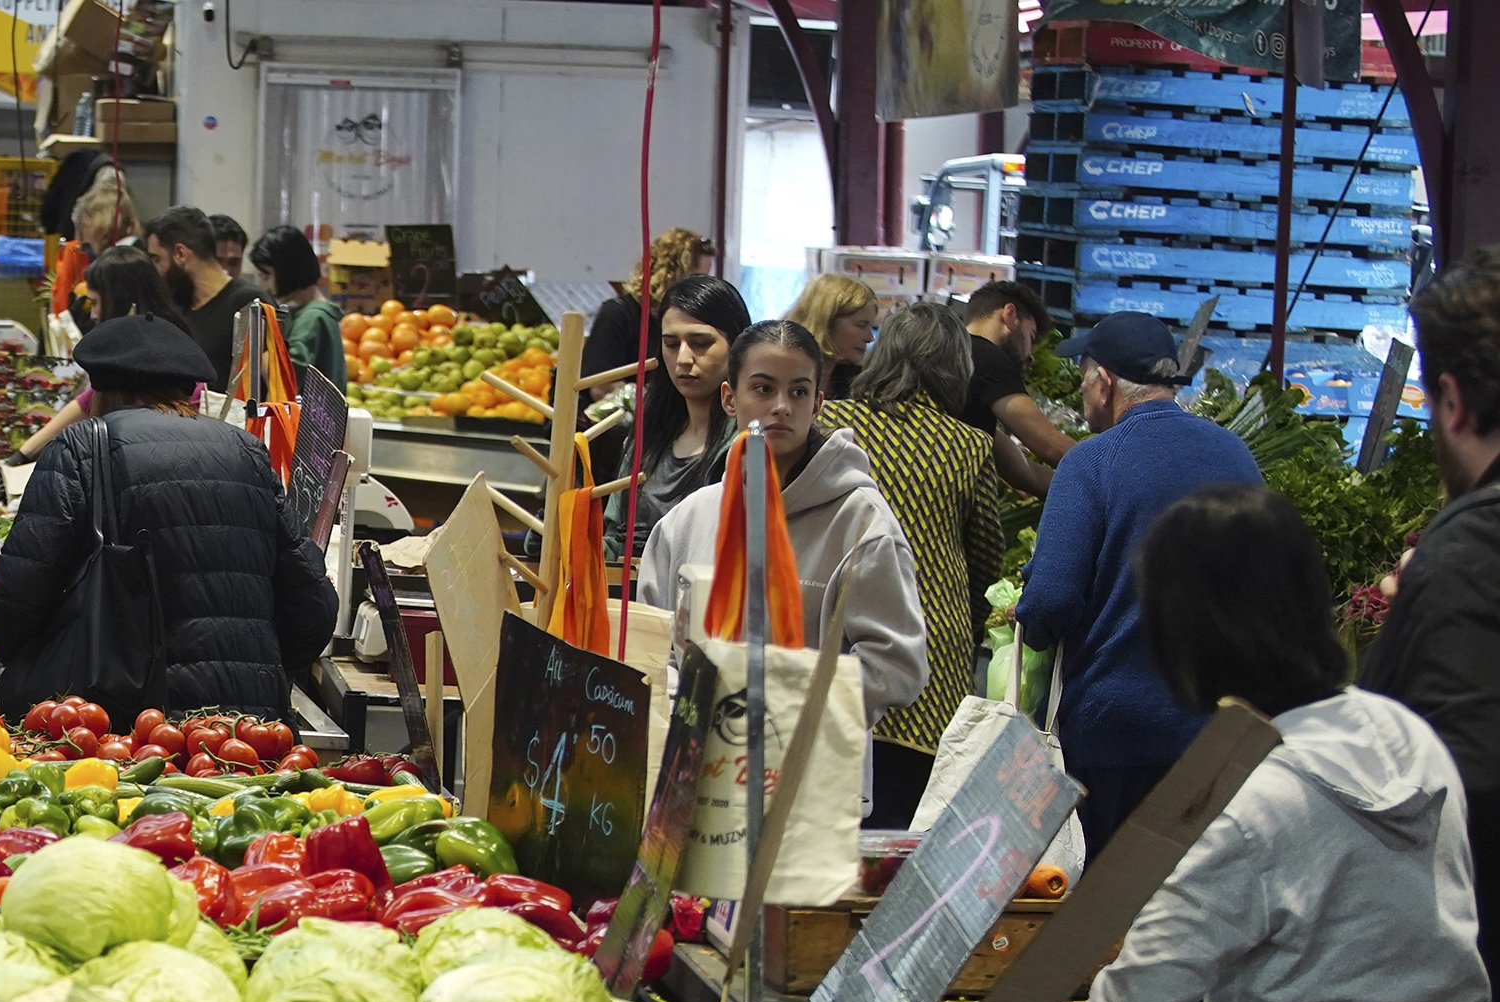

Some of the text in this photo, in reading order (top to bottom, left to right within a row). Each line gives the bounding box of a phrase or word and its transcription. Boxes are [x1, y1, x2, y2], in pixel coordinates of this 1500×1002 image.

[1110, 37, 1164, 51] PROPERTY
[1106, 160, 1164, 176] CHEP
[1111, 205, 1167, 220] CHEP
[1350, 218, 1404, 231] PROPERTY
